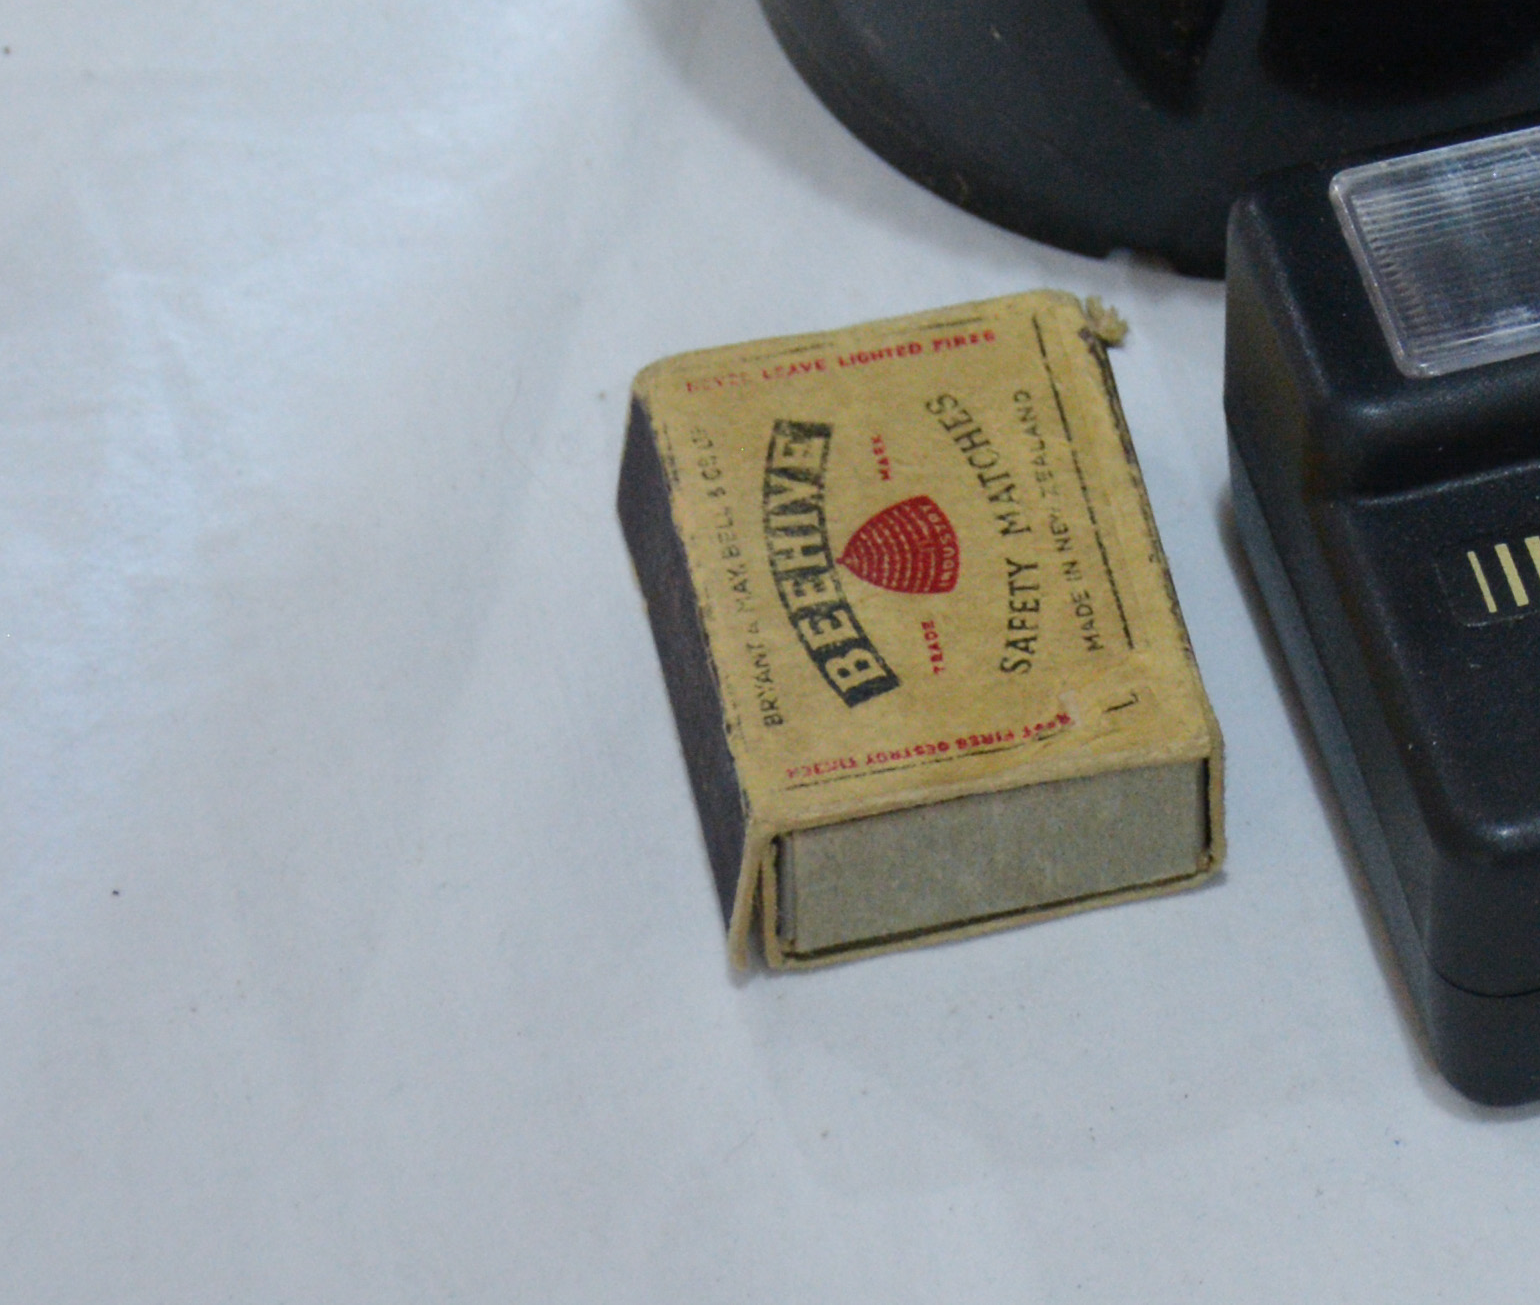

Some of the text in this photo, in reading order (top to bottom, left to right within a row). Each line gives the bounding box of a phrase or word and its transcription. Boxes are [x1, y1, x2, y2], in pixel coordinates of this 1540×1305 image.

[762, 358, 826, 380] LEAVE
[838, 342, 923, 368] LIGHTED
[933, 329, 996, 353] FIRES
[925, 392, 1040, 674] SAFETY MATCHES
[1013, 391, 1104, 652] MADE IN NEW ZEALAND
[764, 433, 890, 695] BEEHIVE
[921, 619, 946, 676] TRADE
[746, 643, 784, 727] BRYANT
[865, 741, 950, 766] DESTROY
[955, 729, 1016, 750] FIRES
